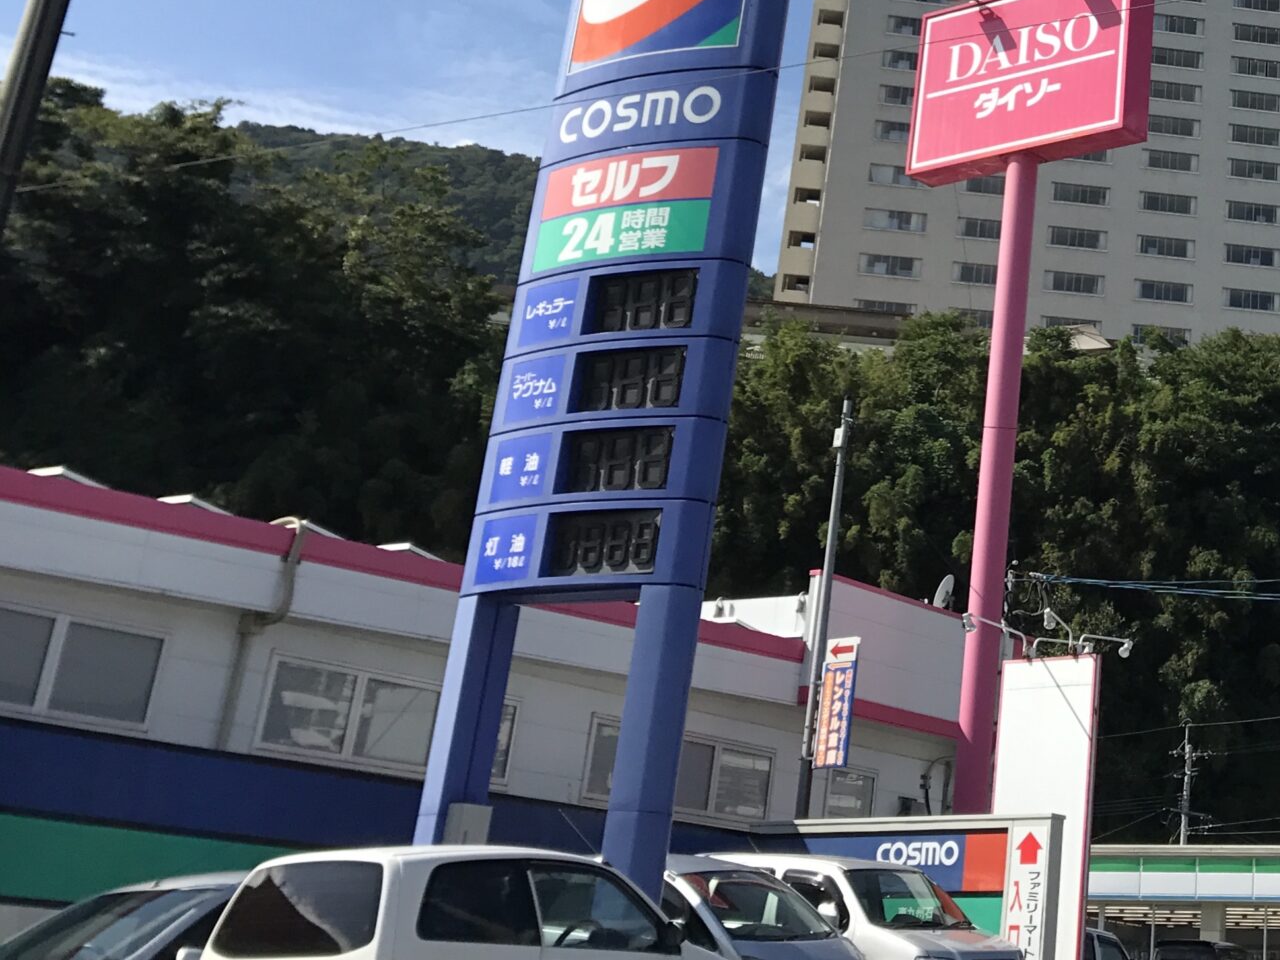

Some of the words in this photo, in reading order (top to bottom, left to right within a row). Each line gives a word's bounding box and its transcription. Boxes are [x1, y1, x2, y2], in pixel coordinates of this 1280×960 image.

[946, 12, 1099, 83] DAISO
[559, 85, 721, 143] COSMO
[974, 78, 1061, 119] ダイソー
[570, 154, 681, 205] セルフ
[557, 212, 616, 261] 24
[525, 297, 574, 320] レギュラー
[513, 377, 556, 399] マグナム
[876, 840, 960, 866] COSMO
